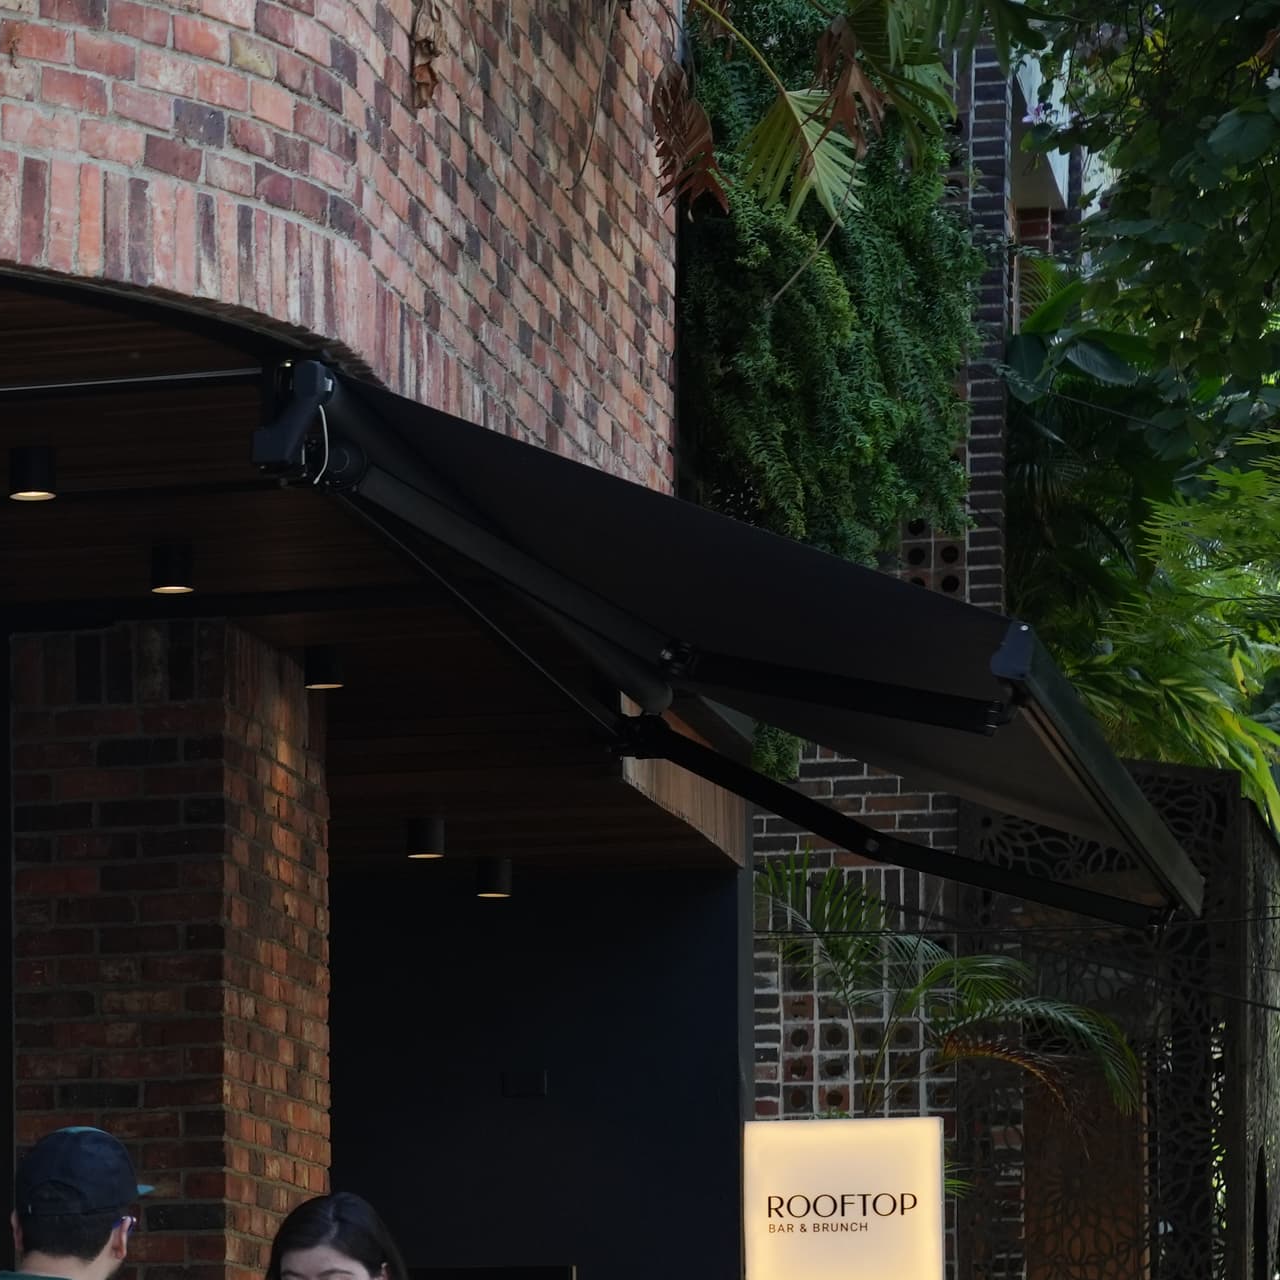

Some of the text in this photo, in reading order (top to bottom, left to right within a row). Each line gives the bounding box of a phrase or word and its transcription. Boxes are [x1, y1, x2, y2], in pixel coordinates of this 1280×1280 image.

[767, 1192, 918, 1219] ROOFTOP
[768, 1222, 869, 1233] BAR & BRUNCH
